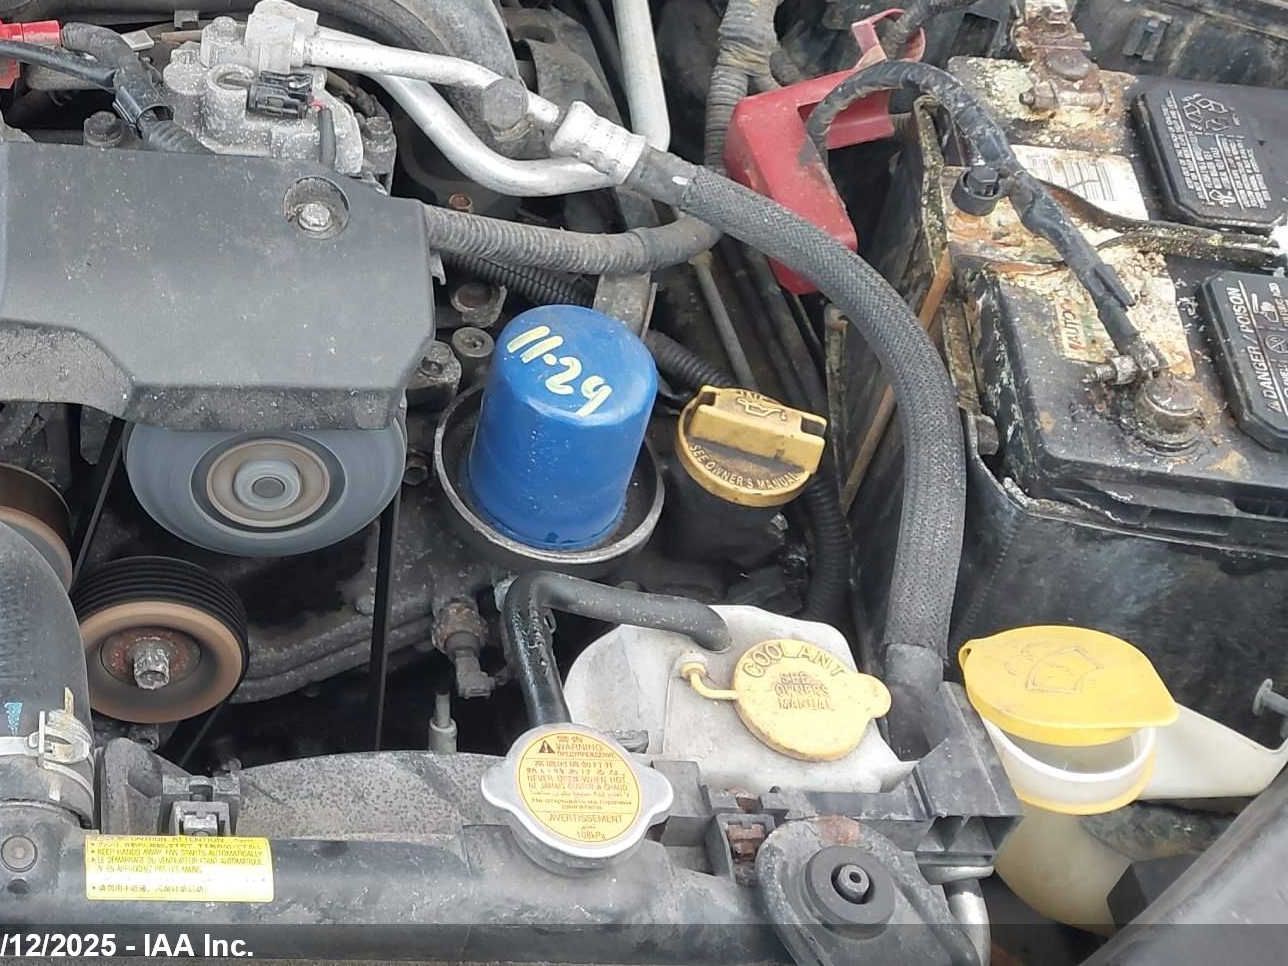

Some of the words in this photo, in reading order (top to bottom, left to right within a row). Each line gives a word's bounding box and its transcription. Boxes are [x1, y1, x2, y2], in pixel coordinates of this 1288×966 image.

[1226, 286, 1255, 334] POISON
[1246, 344, 1279, 400] DANGER
[689, 444, 712, 464] SEE
[705, 461, 754, 489] OWNER'S
[756, 472, 800, 490] MANUAL
[742, 641, 847, 679] COOLANT
[778, 671, 810, 684] SEE
[777, 697, 836, 711] MANUAL
[555, 743, 603, 752] WARNING
[549, 813, 623, 824] AVERTISSEMENT
[180, 849, 207, 857] STARTS
